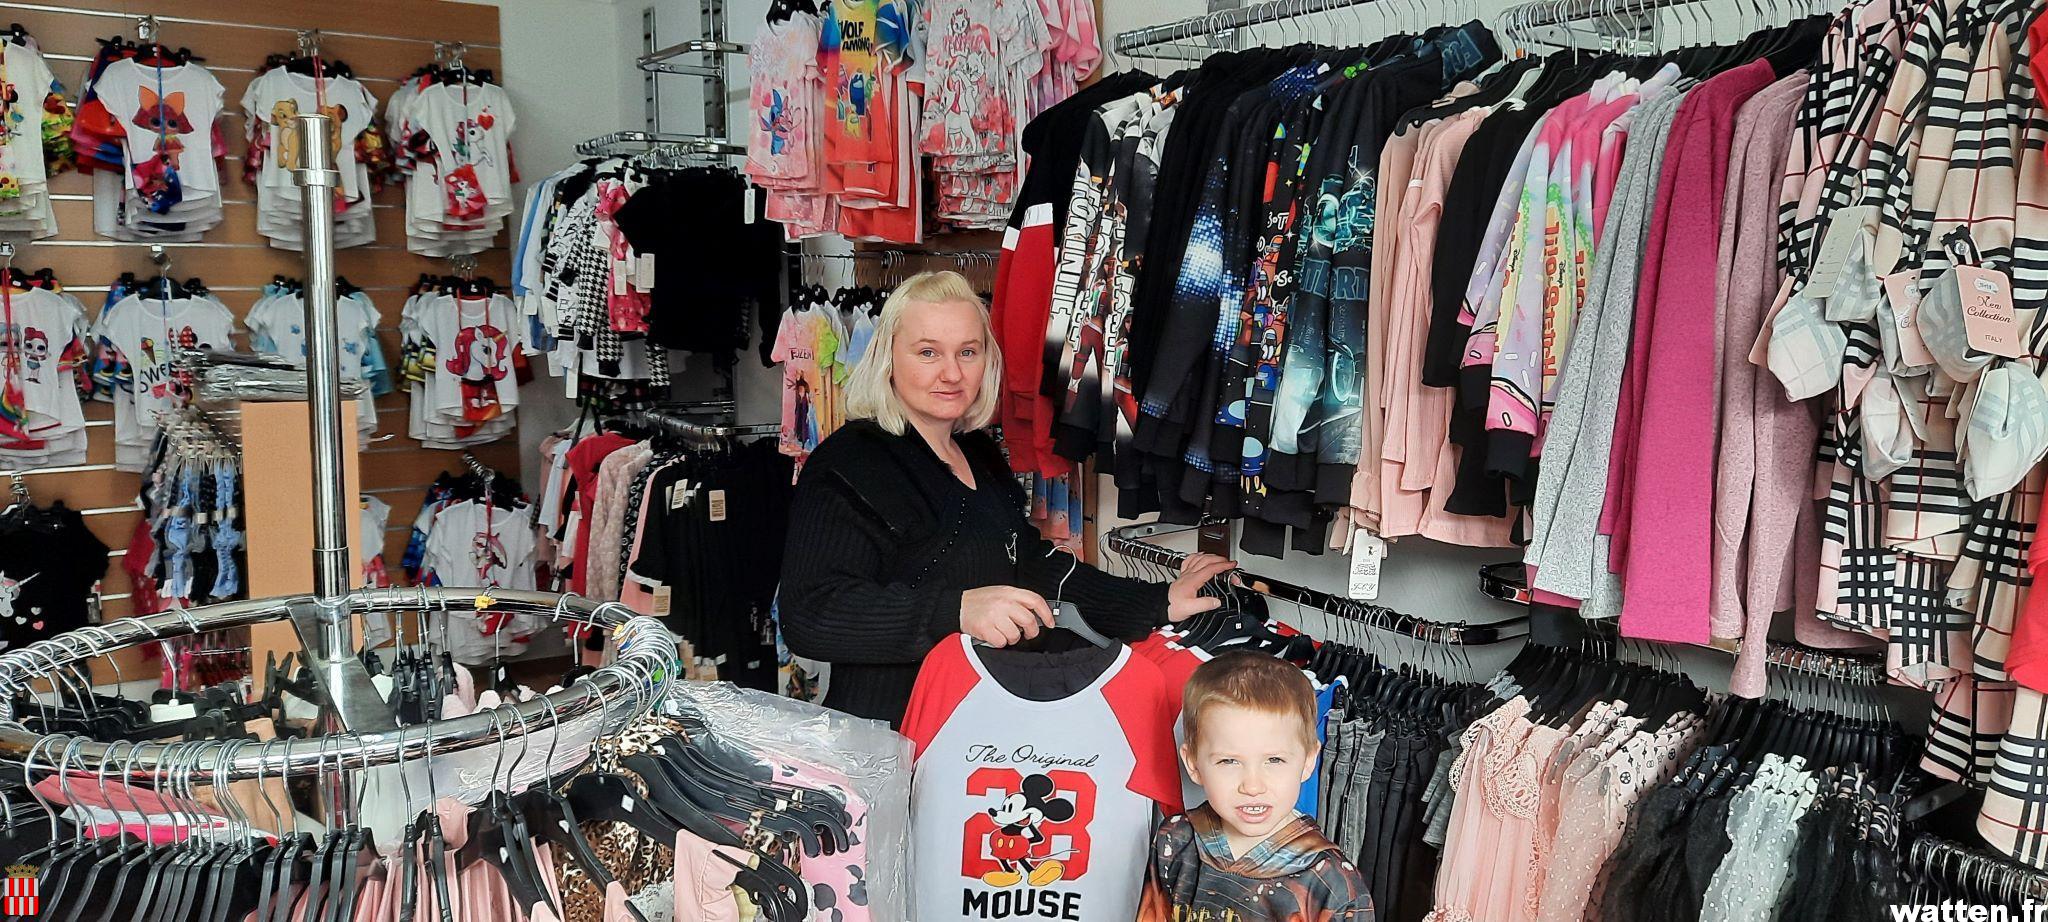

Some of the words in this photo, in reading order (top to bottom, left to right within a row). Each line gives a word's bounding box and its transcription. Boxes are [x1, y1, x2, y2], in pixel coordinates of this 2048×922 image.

[1977, 294, 2002, 310] New
[1966, 305, 2012, 324] Collection
[1984, 334, 2003, 344] ITALY
[965, 744, 1008, 764] The
[1011, 744, 1100, 769] Original
[961, 887, 1082, 922] MOUSE
